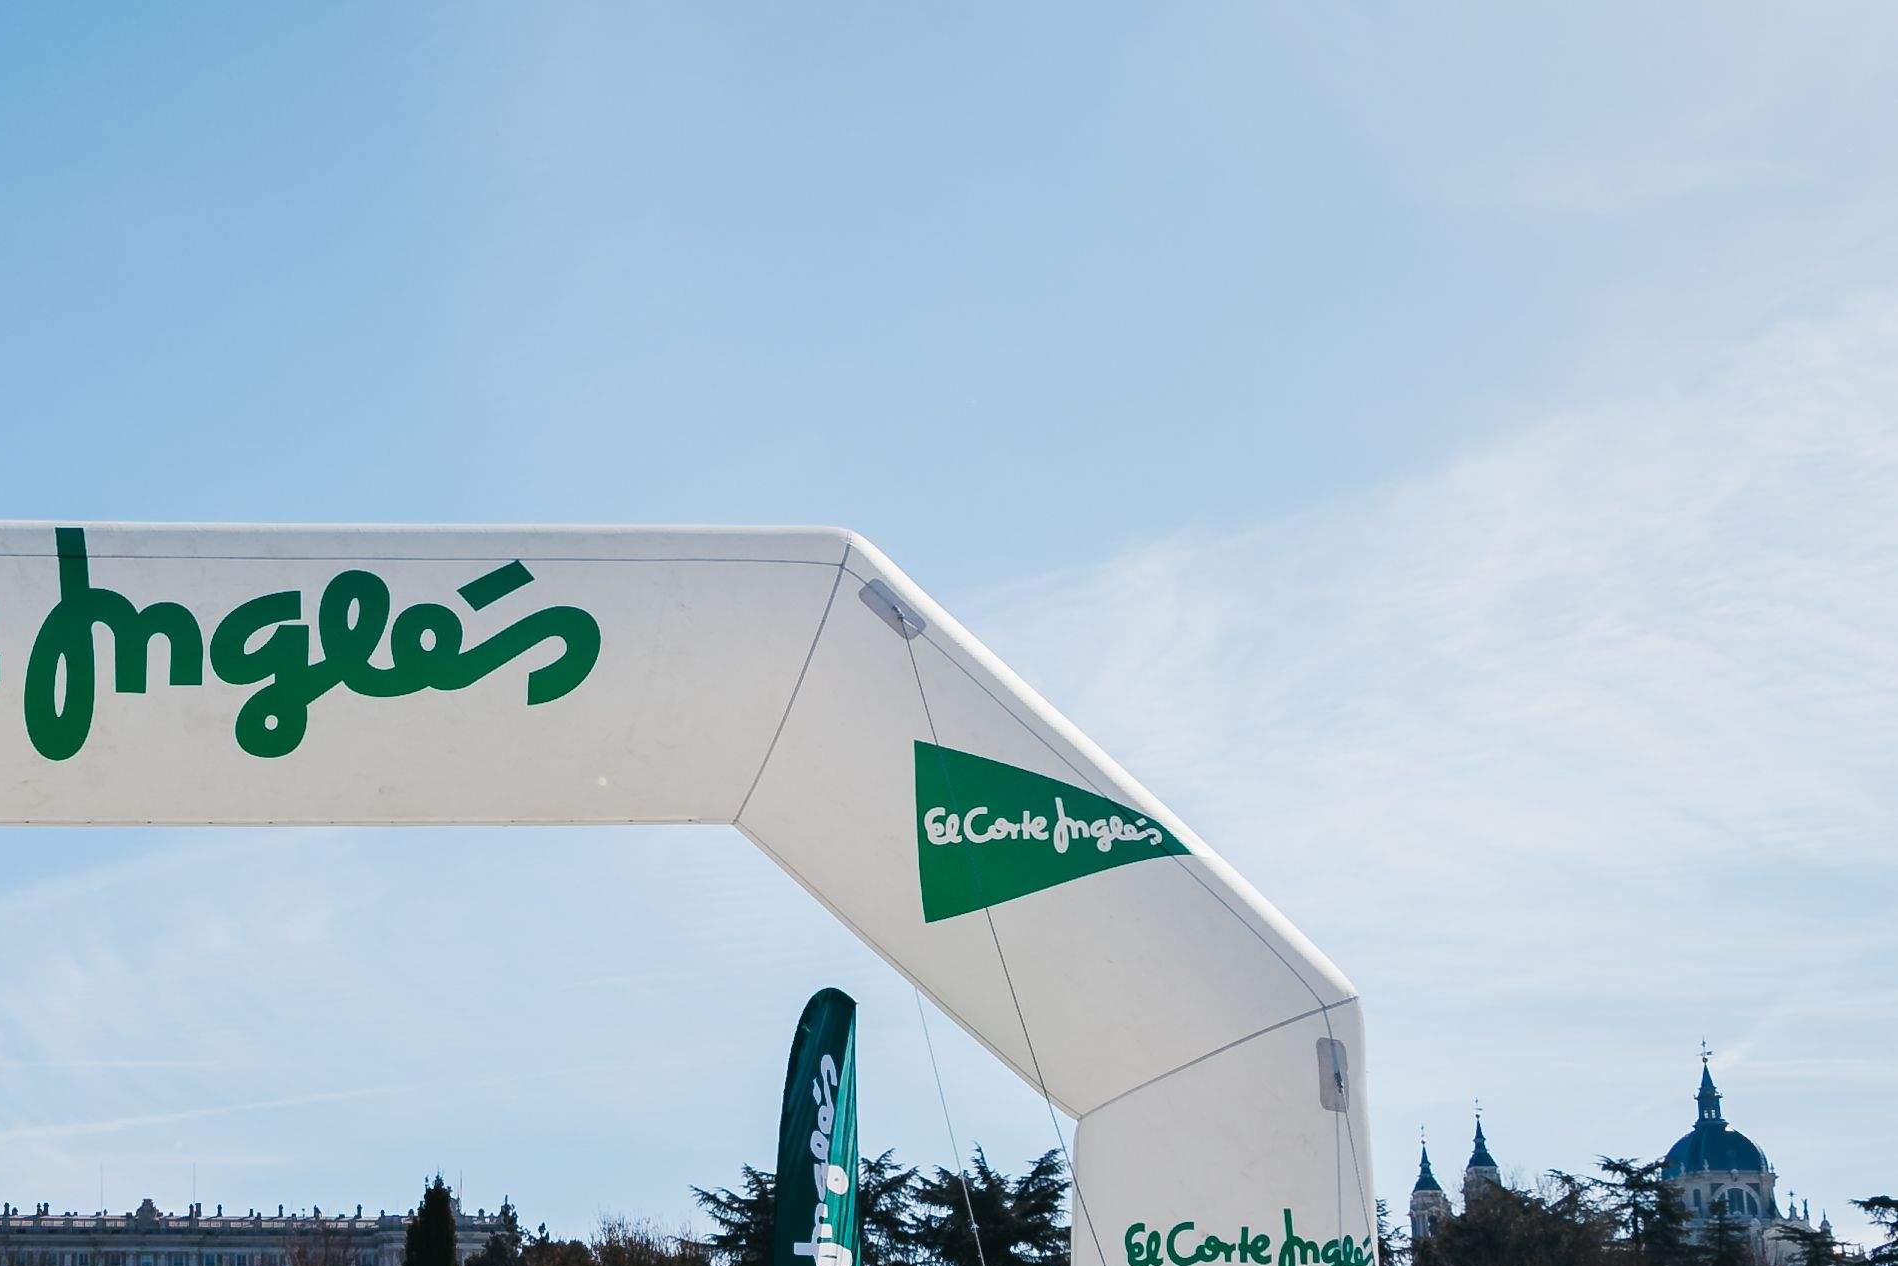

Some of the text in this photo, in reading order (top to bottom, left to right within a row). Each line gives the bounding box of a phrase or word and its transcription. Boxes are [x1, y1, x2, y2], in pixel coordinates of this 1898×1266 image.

[24, 527, 602, 761] Inglés
[924, 797, 1163, 854] El Corte Inglés
[1166, 1221, 1272, 1266] Corte
